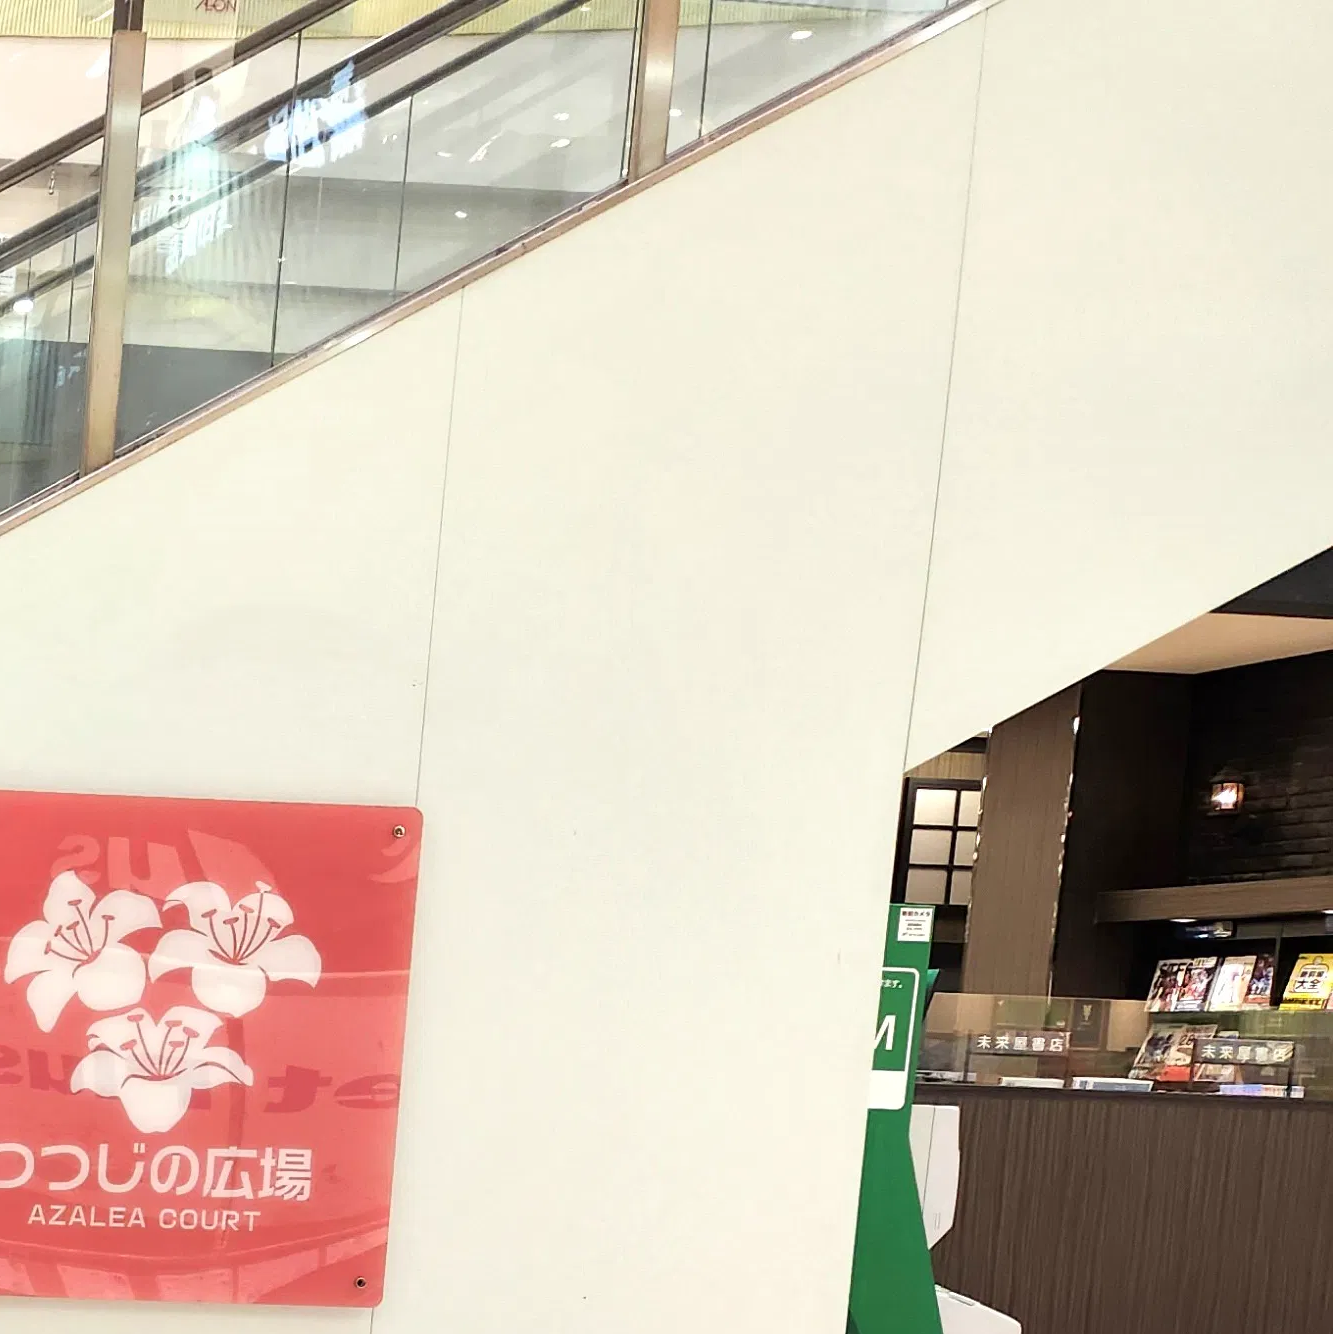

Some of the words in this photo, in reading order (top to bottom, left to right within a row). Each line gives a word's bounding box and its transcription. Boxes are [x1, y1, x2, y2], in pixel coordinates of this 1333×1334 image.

[976, 1034, 1064, 1053] 未来屋書店
[1200, 1043, 1290, 1063] 未来屋書店
[27, 1204, 146, 1229] AZALEA
[159, 1208, 262, 1232] COURT
